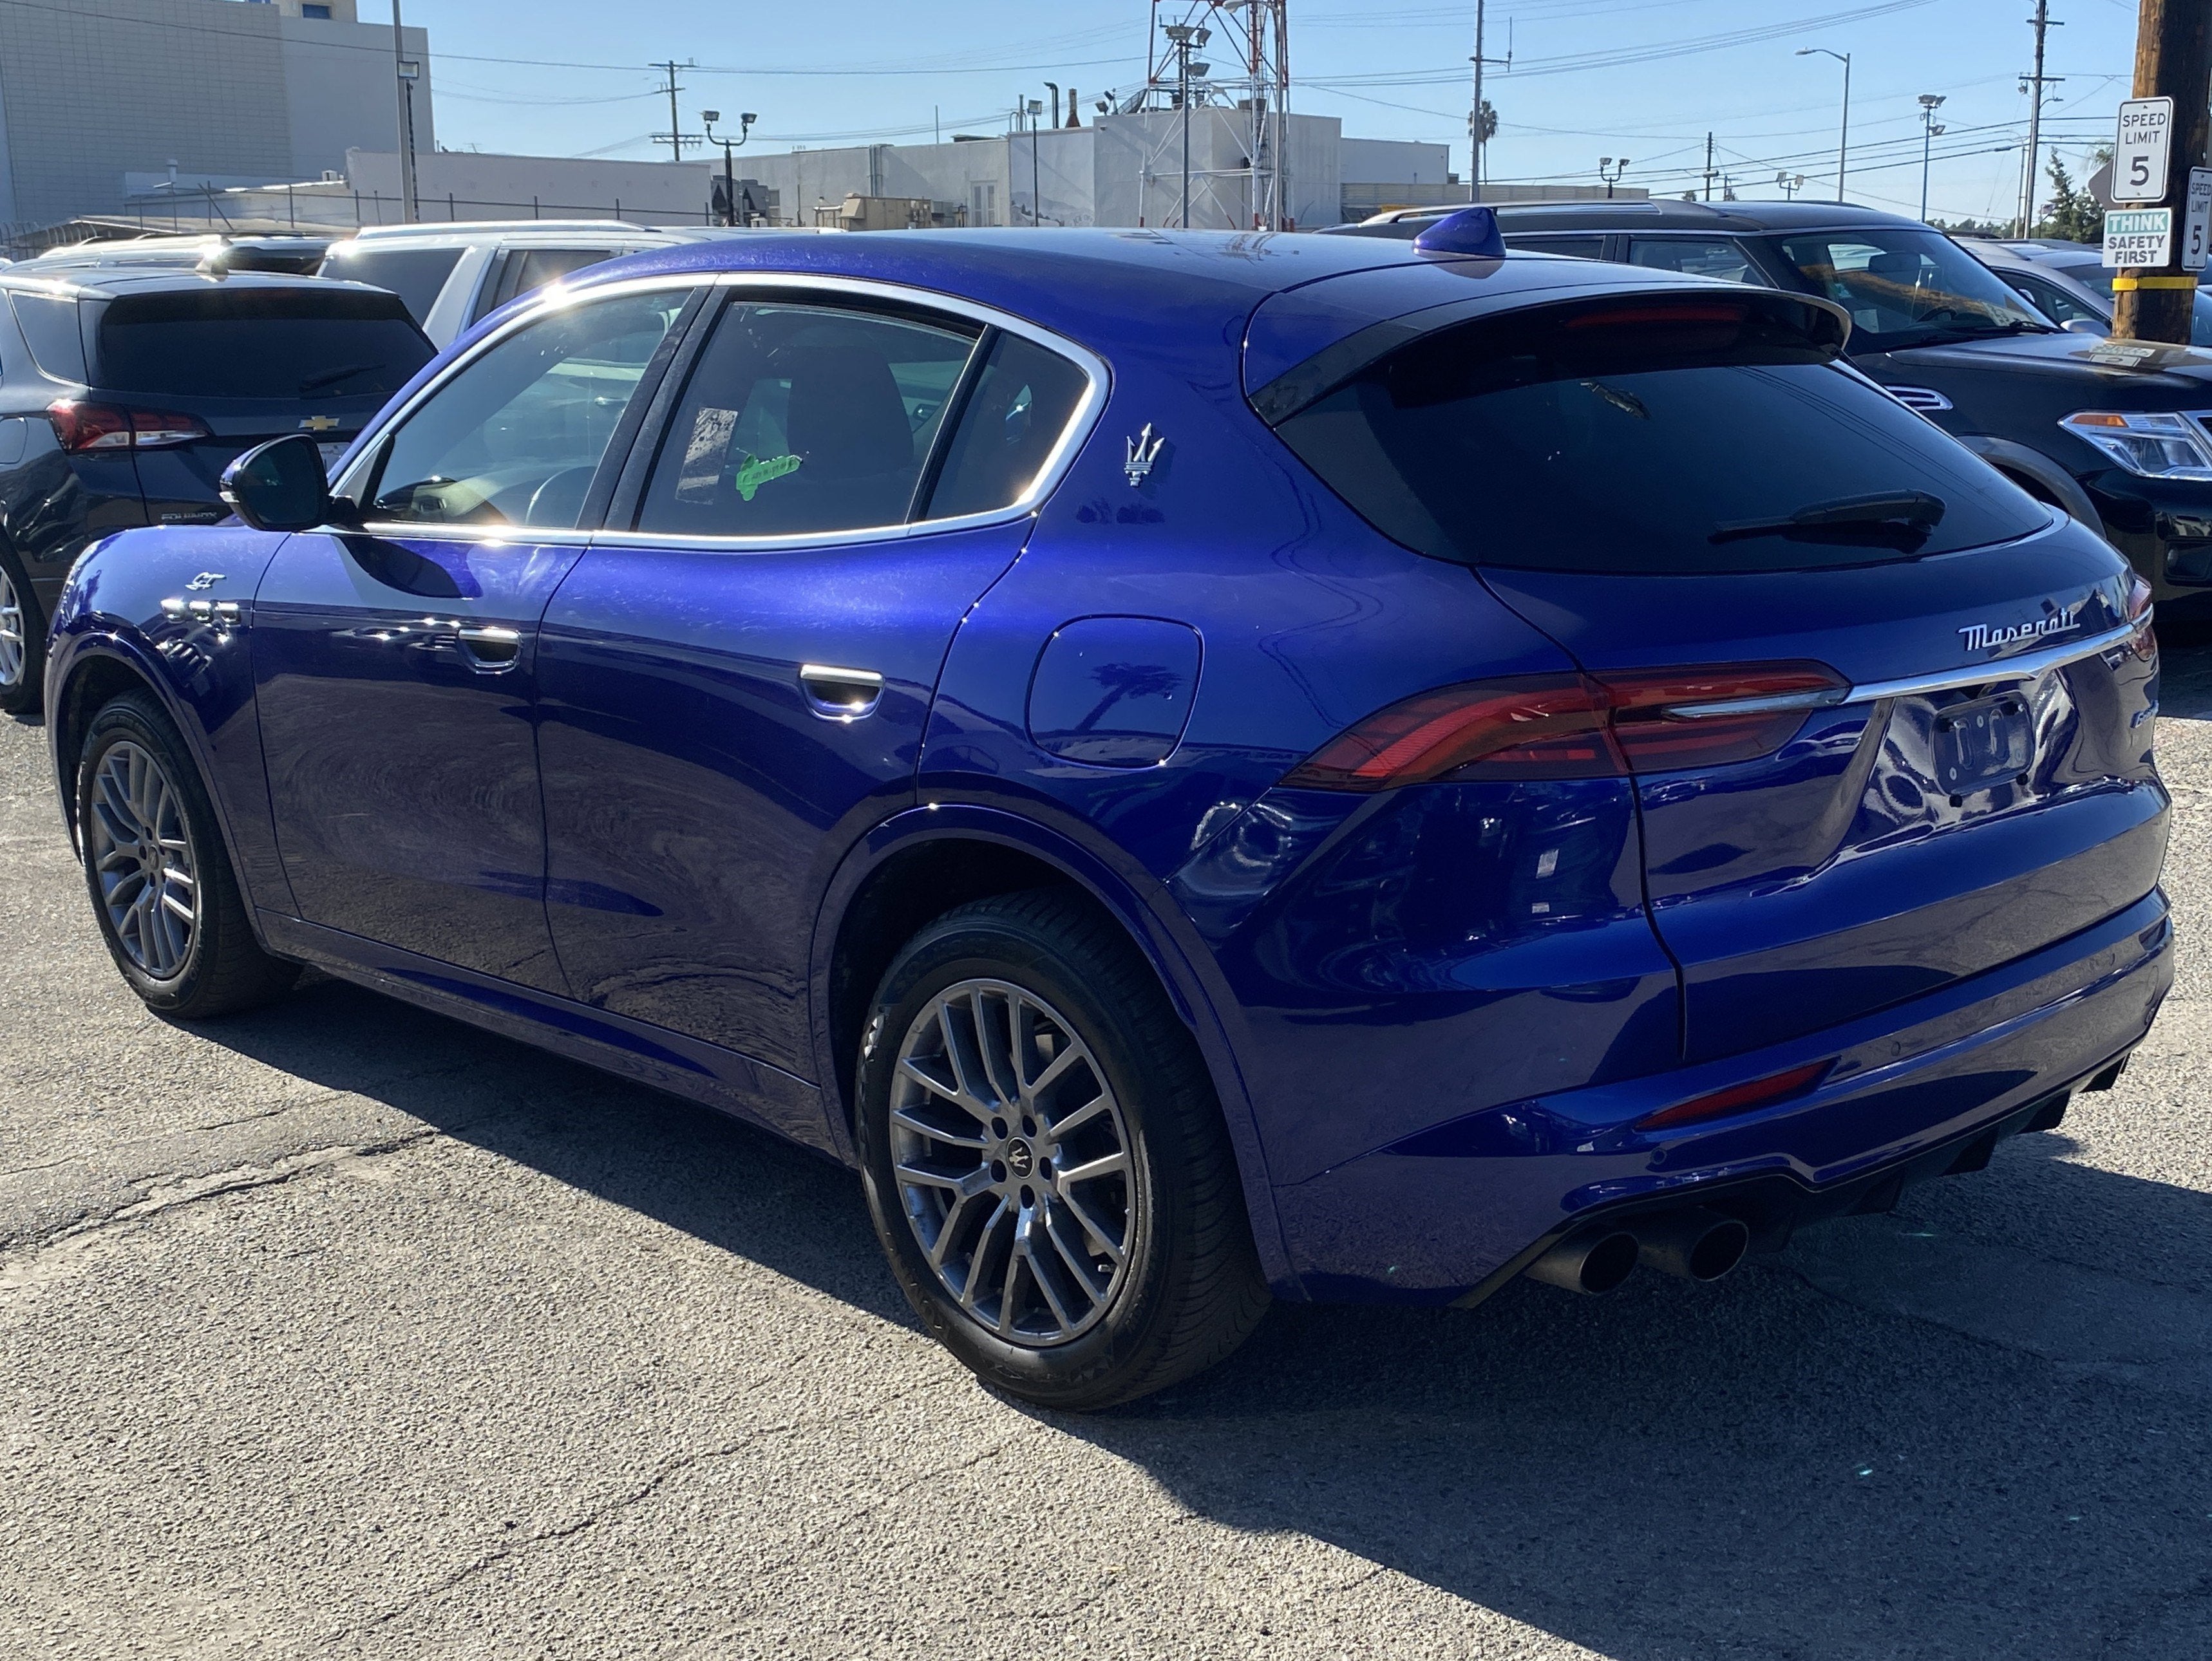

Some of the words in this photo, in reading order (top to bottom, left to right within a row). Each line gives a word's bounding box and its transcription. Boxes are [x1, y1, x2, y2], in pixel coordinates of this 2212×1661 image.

[2122, 113, 2166, 127] SPEED
[2125, 131, 2160, 145] LIMIT
[2130, 156, 2149, 186] 5
[2191, 182, 2211, 196] SPEED
[2191, 201, 2208, 213] LIMIT
[2109, 215, 2166, 232] THINK
[2108, 235, 2165, 249] SAFETY
[2191, 225, 2202, 255] 5
[2115, 250, 2157, 264] FIRST
[1958, 608, 2081, 650] Maserati
